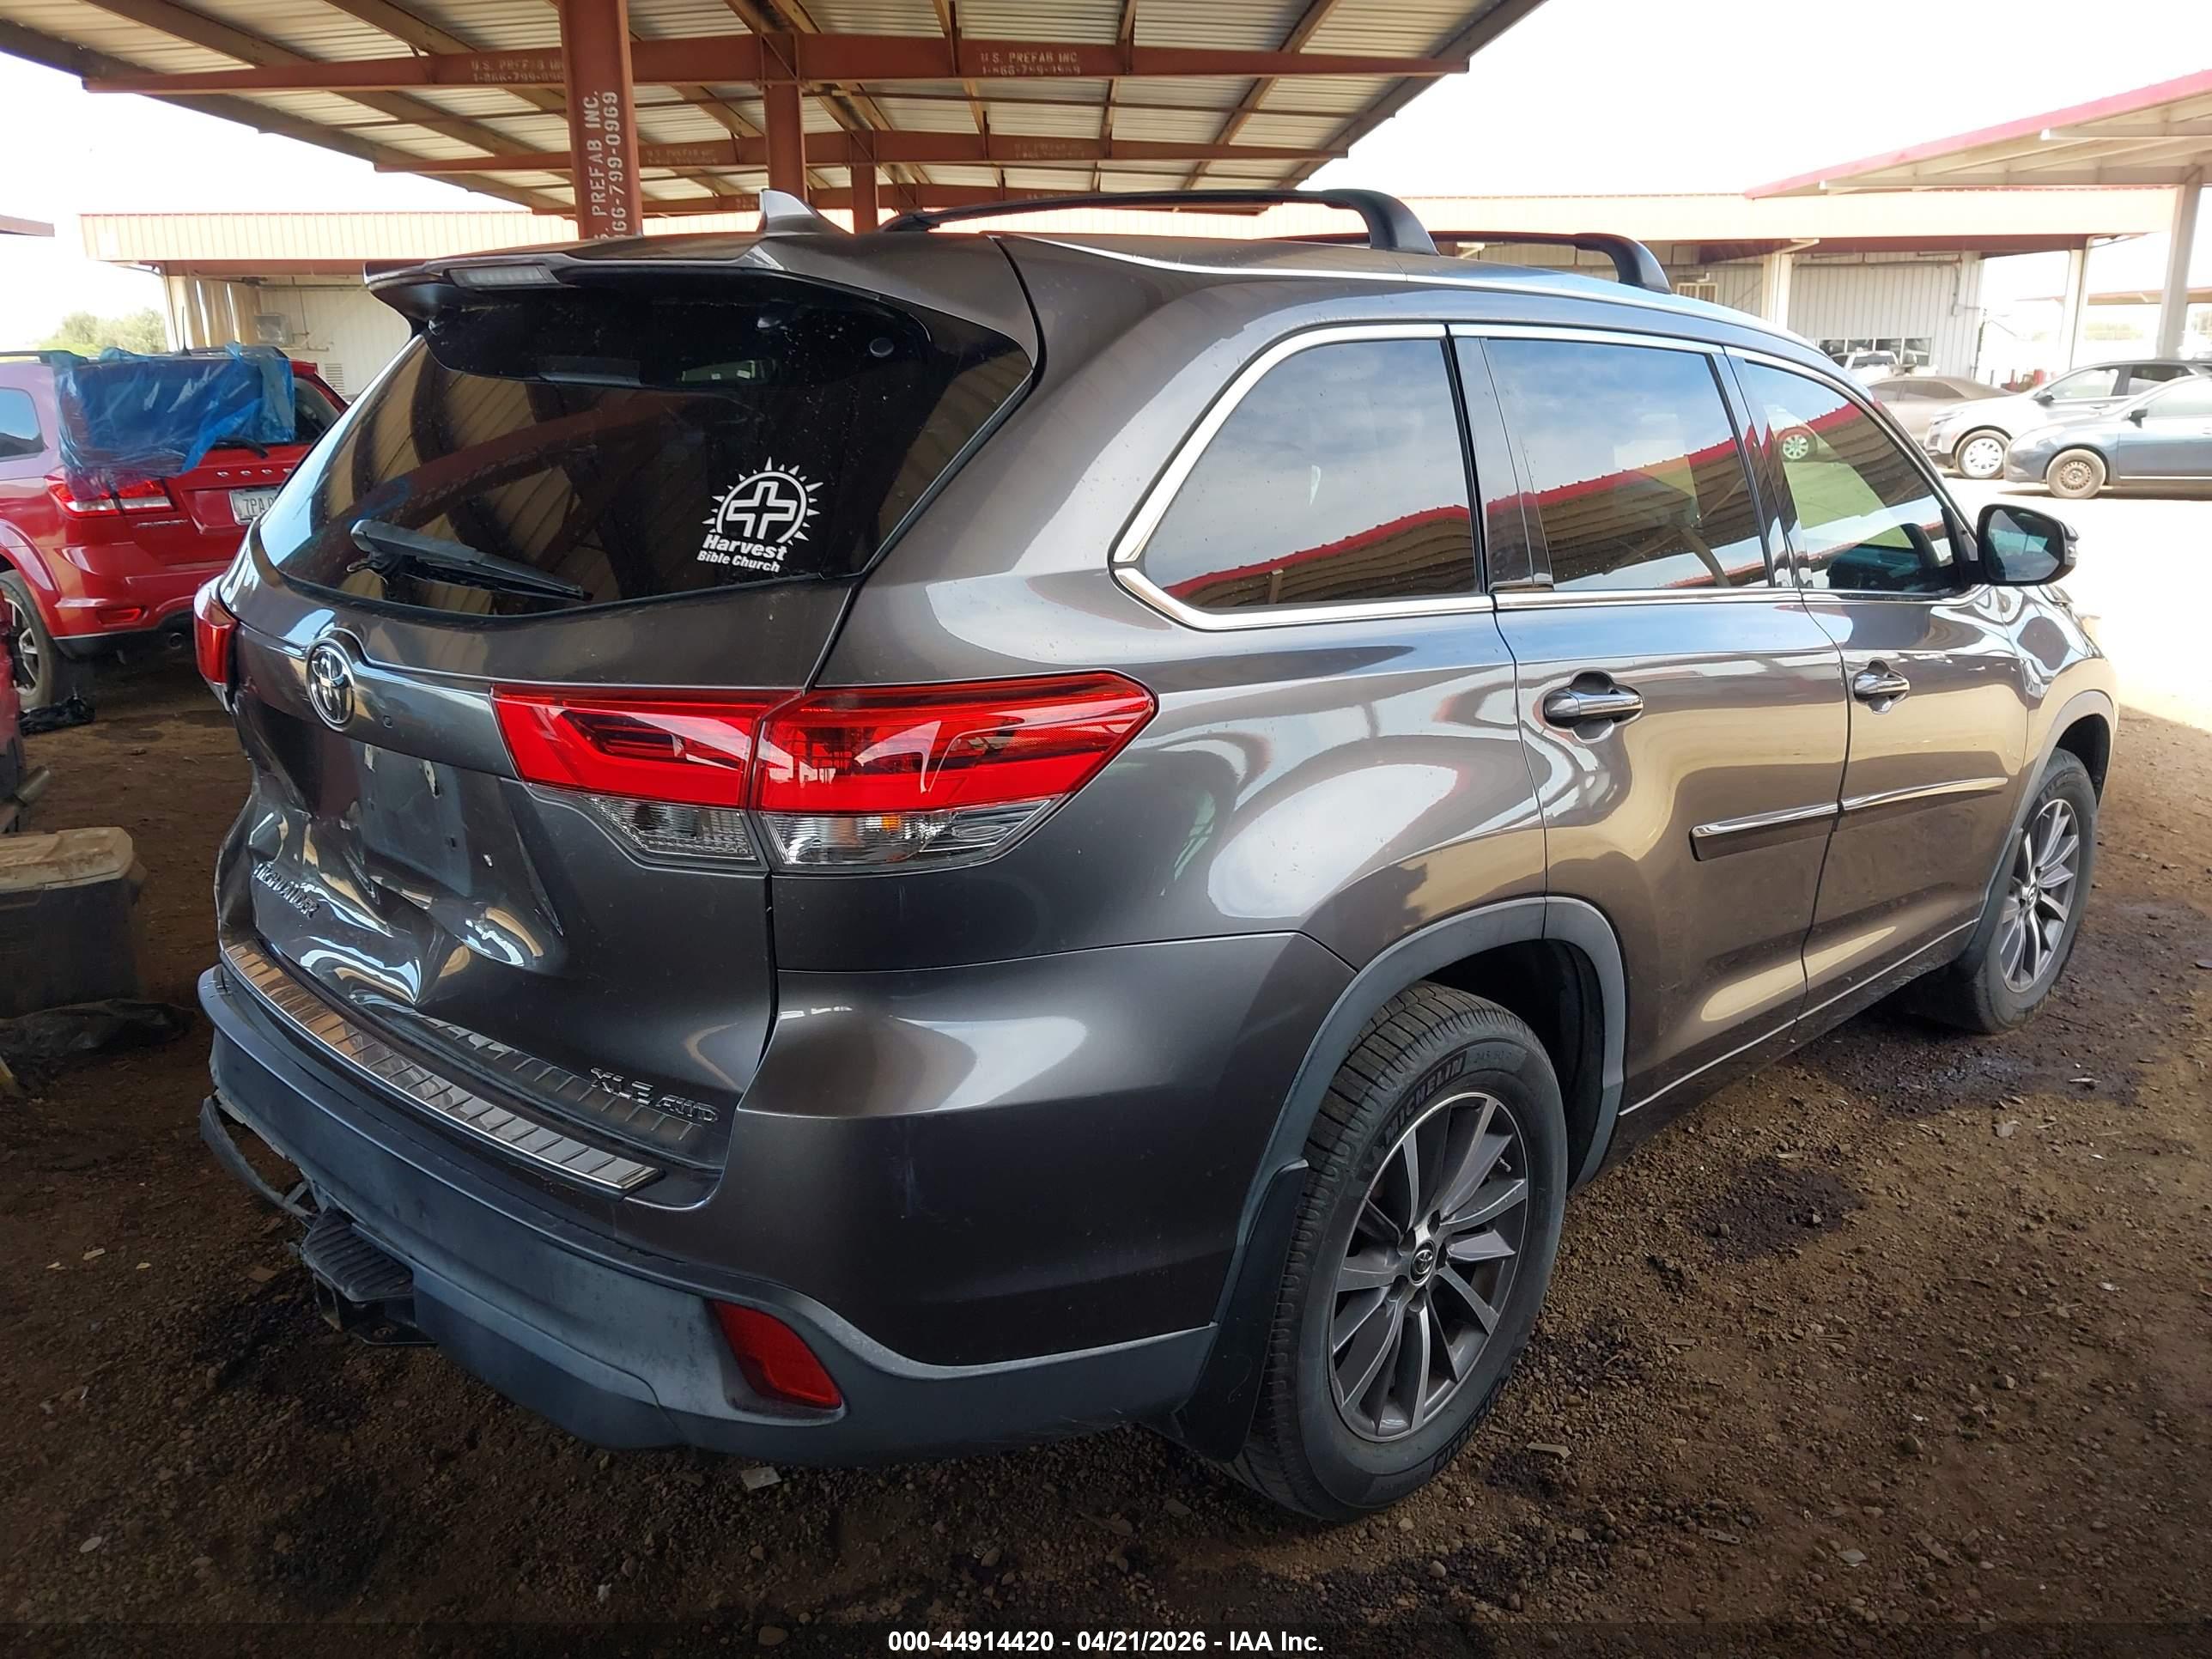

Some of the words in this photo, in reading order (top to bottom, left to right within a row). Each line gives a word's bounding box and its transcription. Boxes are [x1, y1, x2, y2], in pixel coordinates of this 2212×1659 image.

[583, 90, 602, 130] INC.
[586, 139, 608, 217] PREFAB
[696, 550, 731, 565] Bible
[732, 555, 781, 573] Church
[702, 533, 787, 561] Harvest
[590, 1067, 653, 1106] XLE
[1384, 1056, 1464, 1146] MICHELIN
